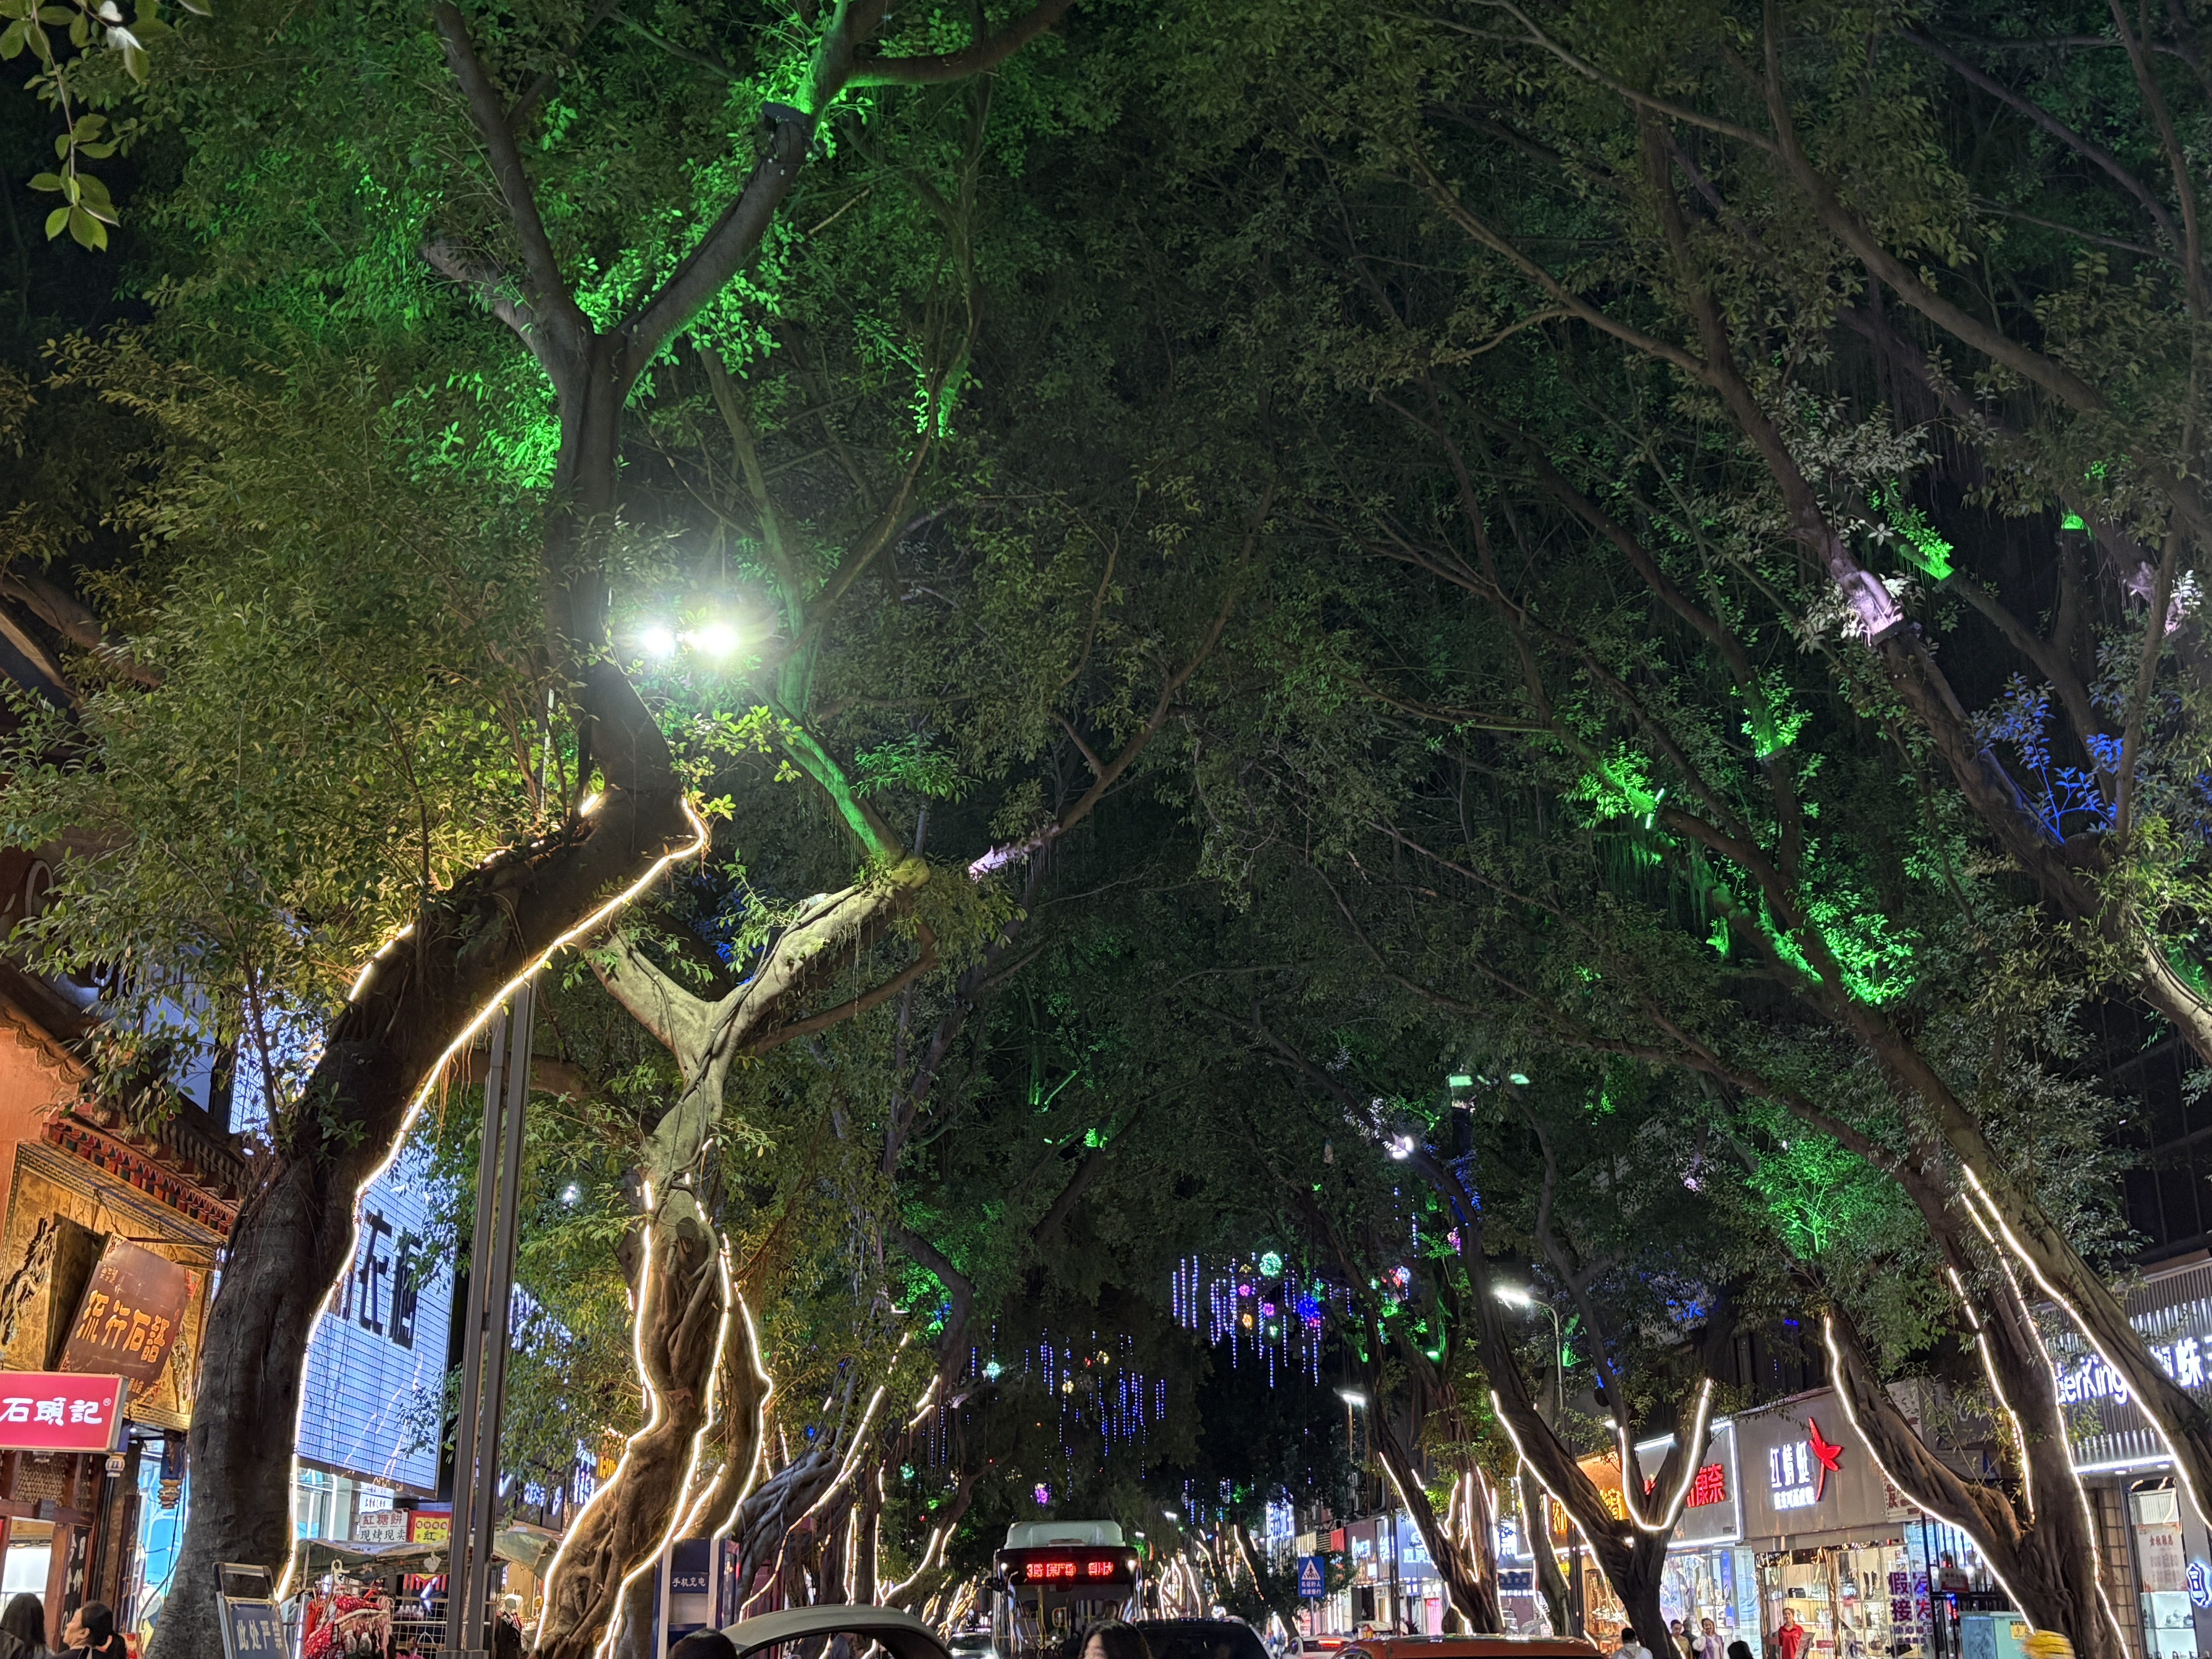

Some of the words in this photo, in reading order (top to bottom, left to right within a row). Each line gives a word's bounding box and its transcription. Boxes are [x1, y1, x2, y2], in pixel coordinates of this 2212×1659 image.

[0, 1397, 102, 1426] 石頭記
[360, 1528, 405, 1542] 现烤现卖
[672, 1577, 706, 1587] 手机充电
